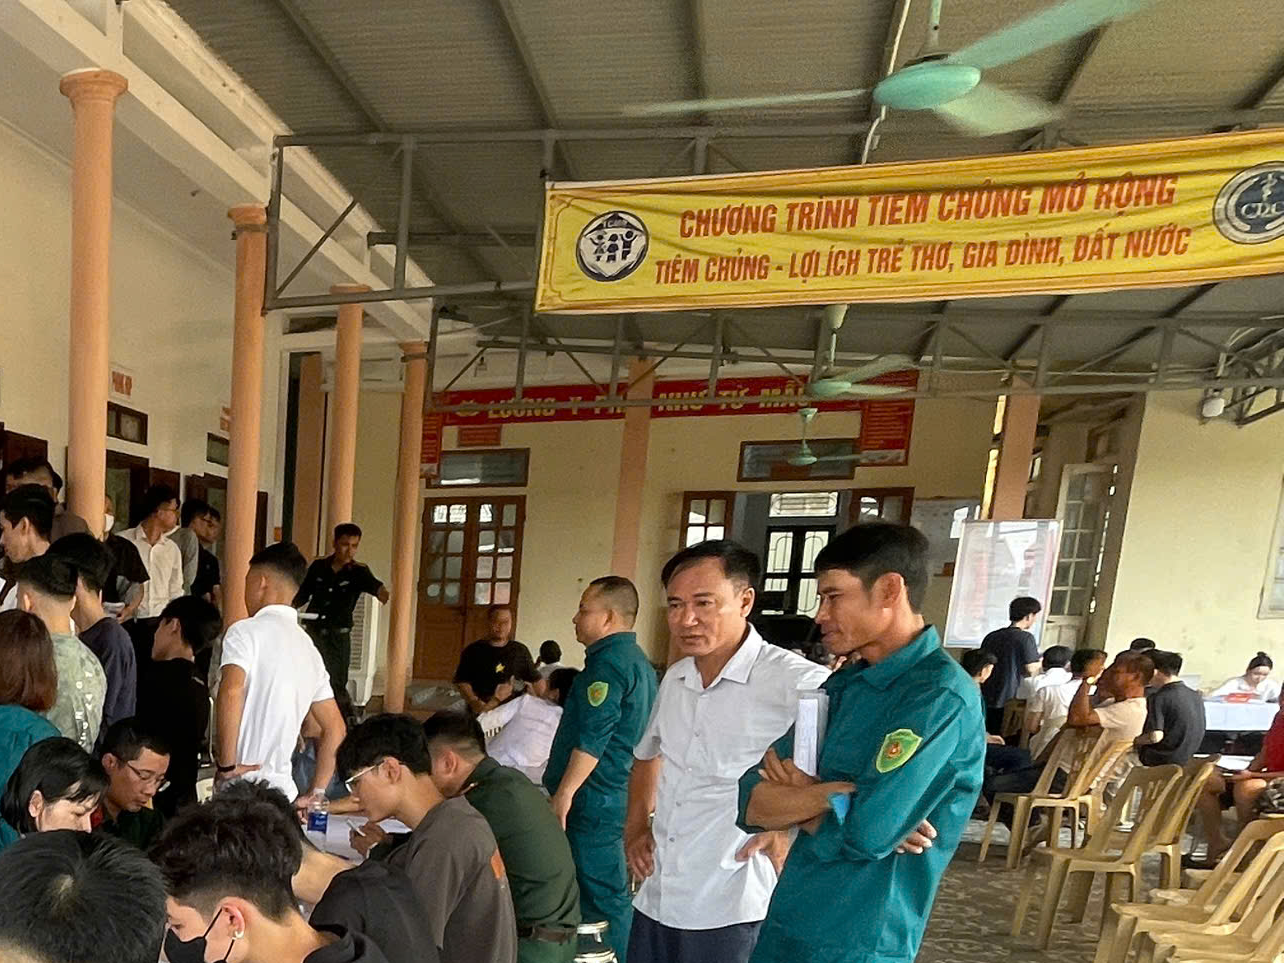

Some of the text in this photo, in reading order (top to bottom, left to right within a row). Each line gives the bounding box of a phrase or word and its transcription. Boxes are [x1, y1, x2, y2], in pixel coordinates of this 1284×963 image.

[680, 203, 778, 238] CHƯƠNG
[786, 195, 860, 232] TRÌNH
[655, 254, 700, 284] TIÊM
[788, 249, 820, 284] LỢI
[825, 244, 861, 277] ÍCH
[911, 241, 955, 273] THƠ,
[962, 241, 998, 268] GIA
[1124, 222, 1192, 259] NƯỚC
